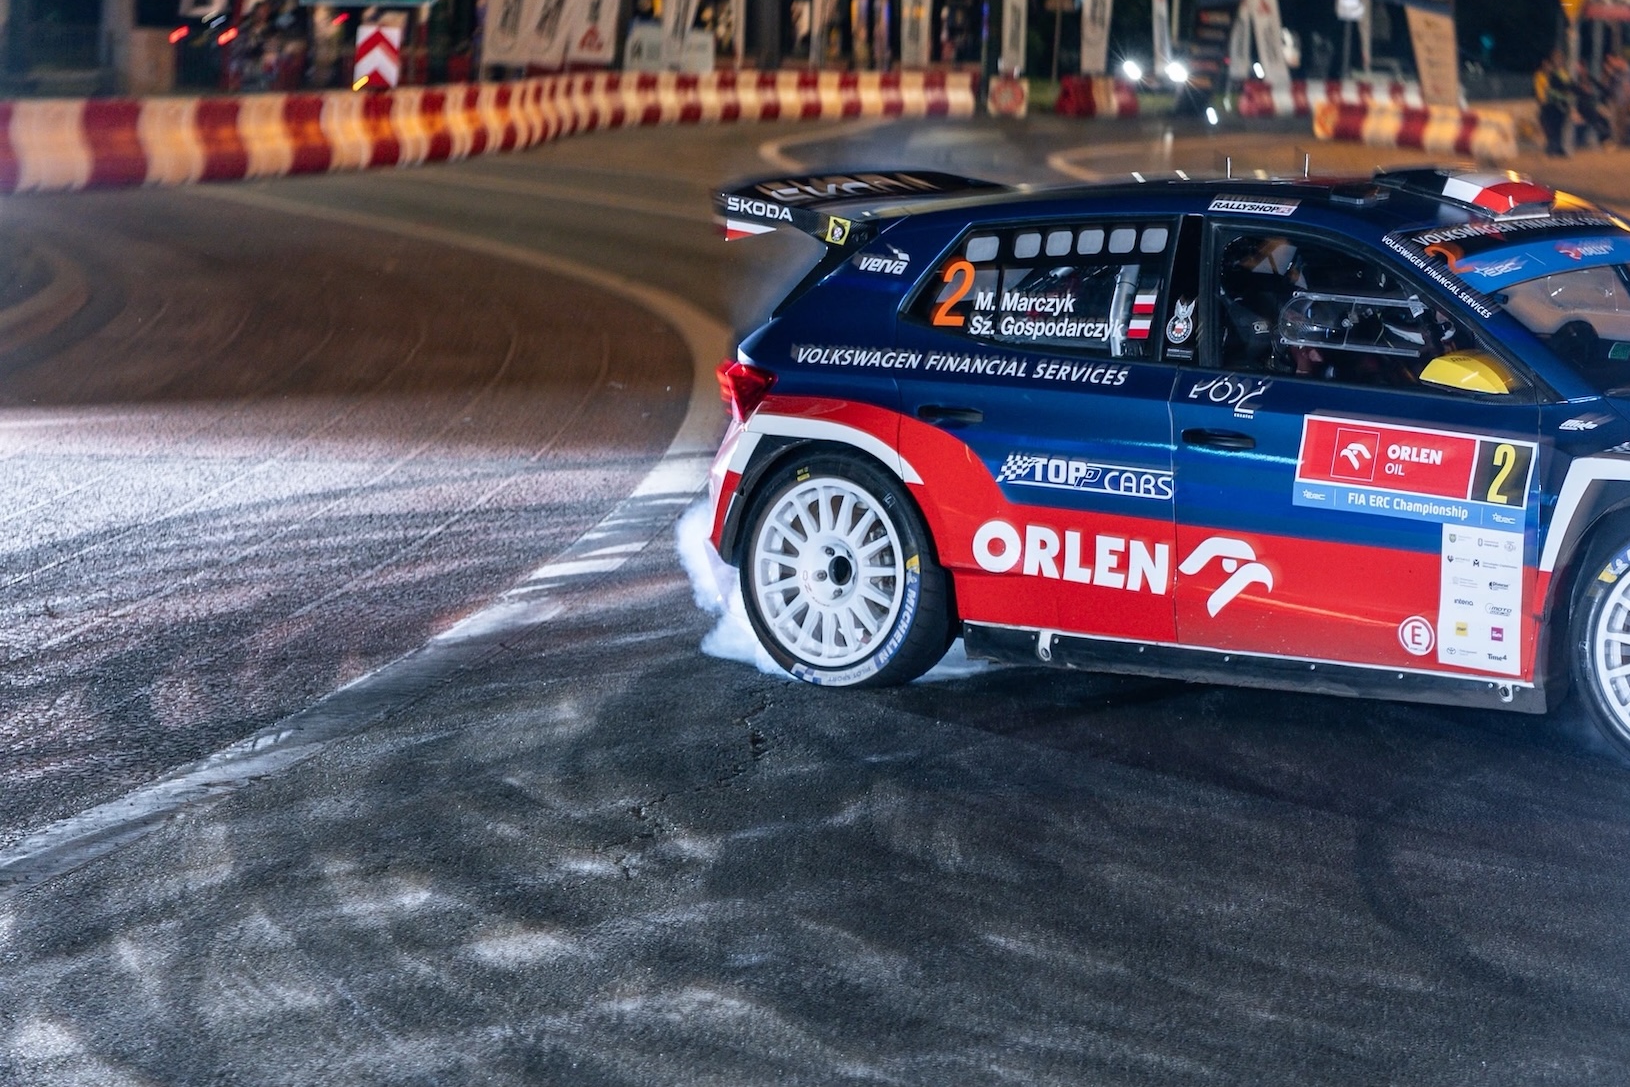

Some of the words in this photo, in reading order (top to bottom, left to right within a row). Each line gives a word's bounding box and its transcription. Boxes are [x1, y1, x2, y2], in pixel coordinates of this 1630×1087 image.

[859, 256, 909, 275] verva
[1381, 235, 1426, 270] VOLKSWAGEN
[1424, 266, 1459, 295] FINANCIAL
[1458, 293, 1492, 319] SERVICES
[932, 260, 976, 327] 2
[974, 291, 996, 311] M.
[1000, 292, 1077, 316] Marczyk
[969, 316, 996, 335] Sz.
[1000, 316, 1124, 341] Gospodarczyk
[796, 348, 922, 370] VOLKSWAGEN
[924, 355, 1028, 378] FINANCIAL
[1032, 363, 1130, 386] SERVICES
[1387, 444, 1443, 465] ORLEN
[1385, 463, 1405, 476] OIL
[1486, 443, 1516, 504] 2
[1103, 471, 1174, 500] CARS
[1347, 492, 1366, 505] FIA
[1369, 495, 1390, 510] ERC
[1393, 497, 1468, 520] Championship
[972, 520, 1170, 596] ORLEN
[878, 588, 917, 664] MICHELIN
[1411, 625, 1423, 646] E
